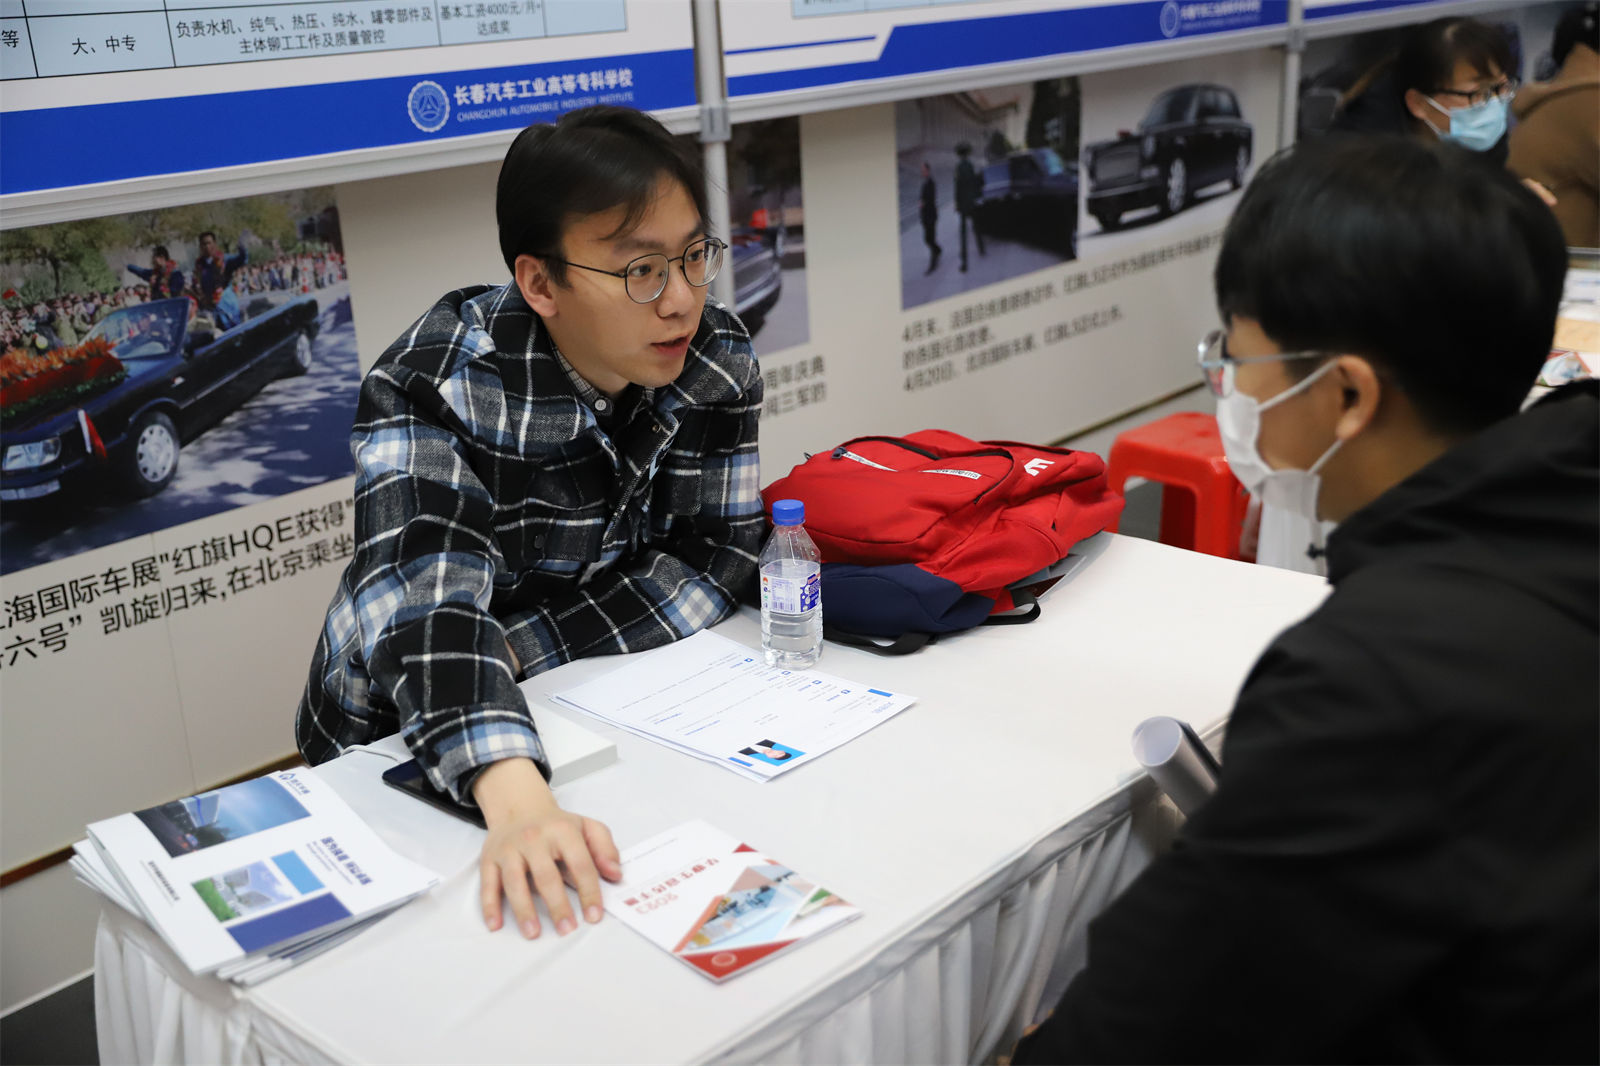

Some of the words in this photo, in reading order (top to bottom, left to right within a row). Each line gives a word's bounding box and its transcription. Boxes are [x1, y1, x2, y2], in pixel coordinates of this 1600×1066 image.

[477, 20, 511, 36] 达成奖
[72, 35, 136, 55] 大、中专
[454, 68, 634, 106] 长春汽车工业高等专科学校
[457, 107, 507, 122] CHANGCHUN
[509, 102, 559, 116] AUTOMOBILE
[561, 96, 597, 110] INDUSTRY
[0, 498, 354, 630] 海国际车展"红旗HQE获得"
[636, 892, 679, 914] 2023
